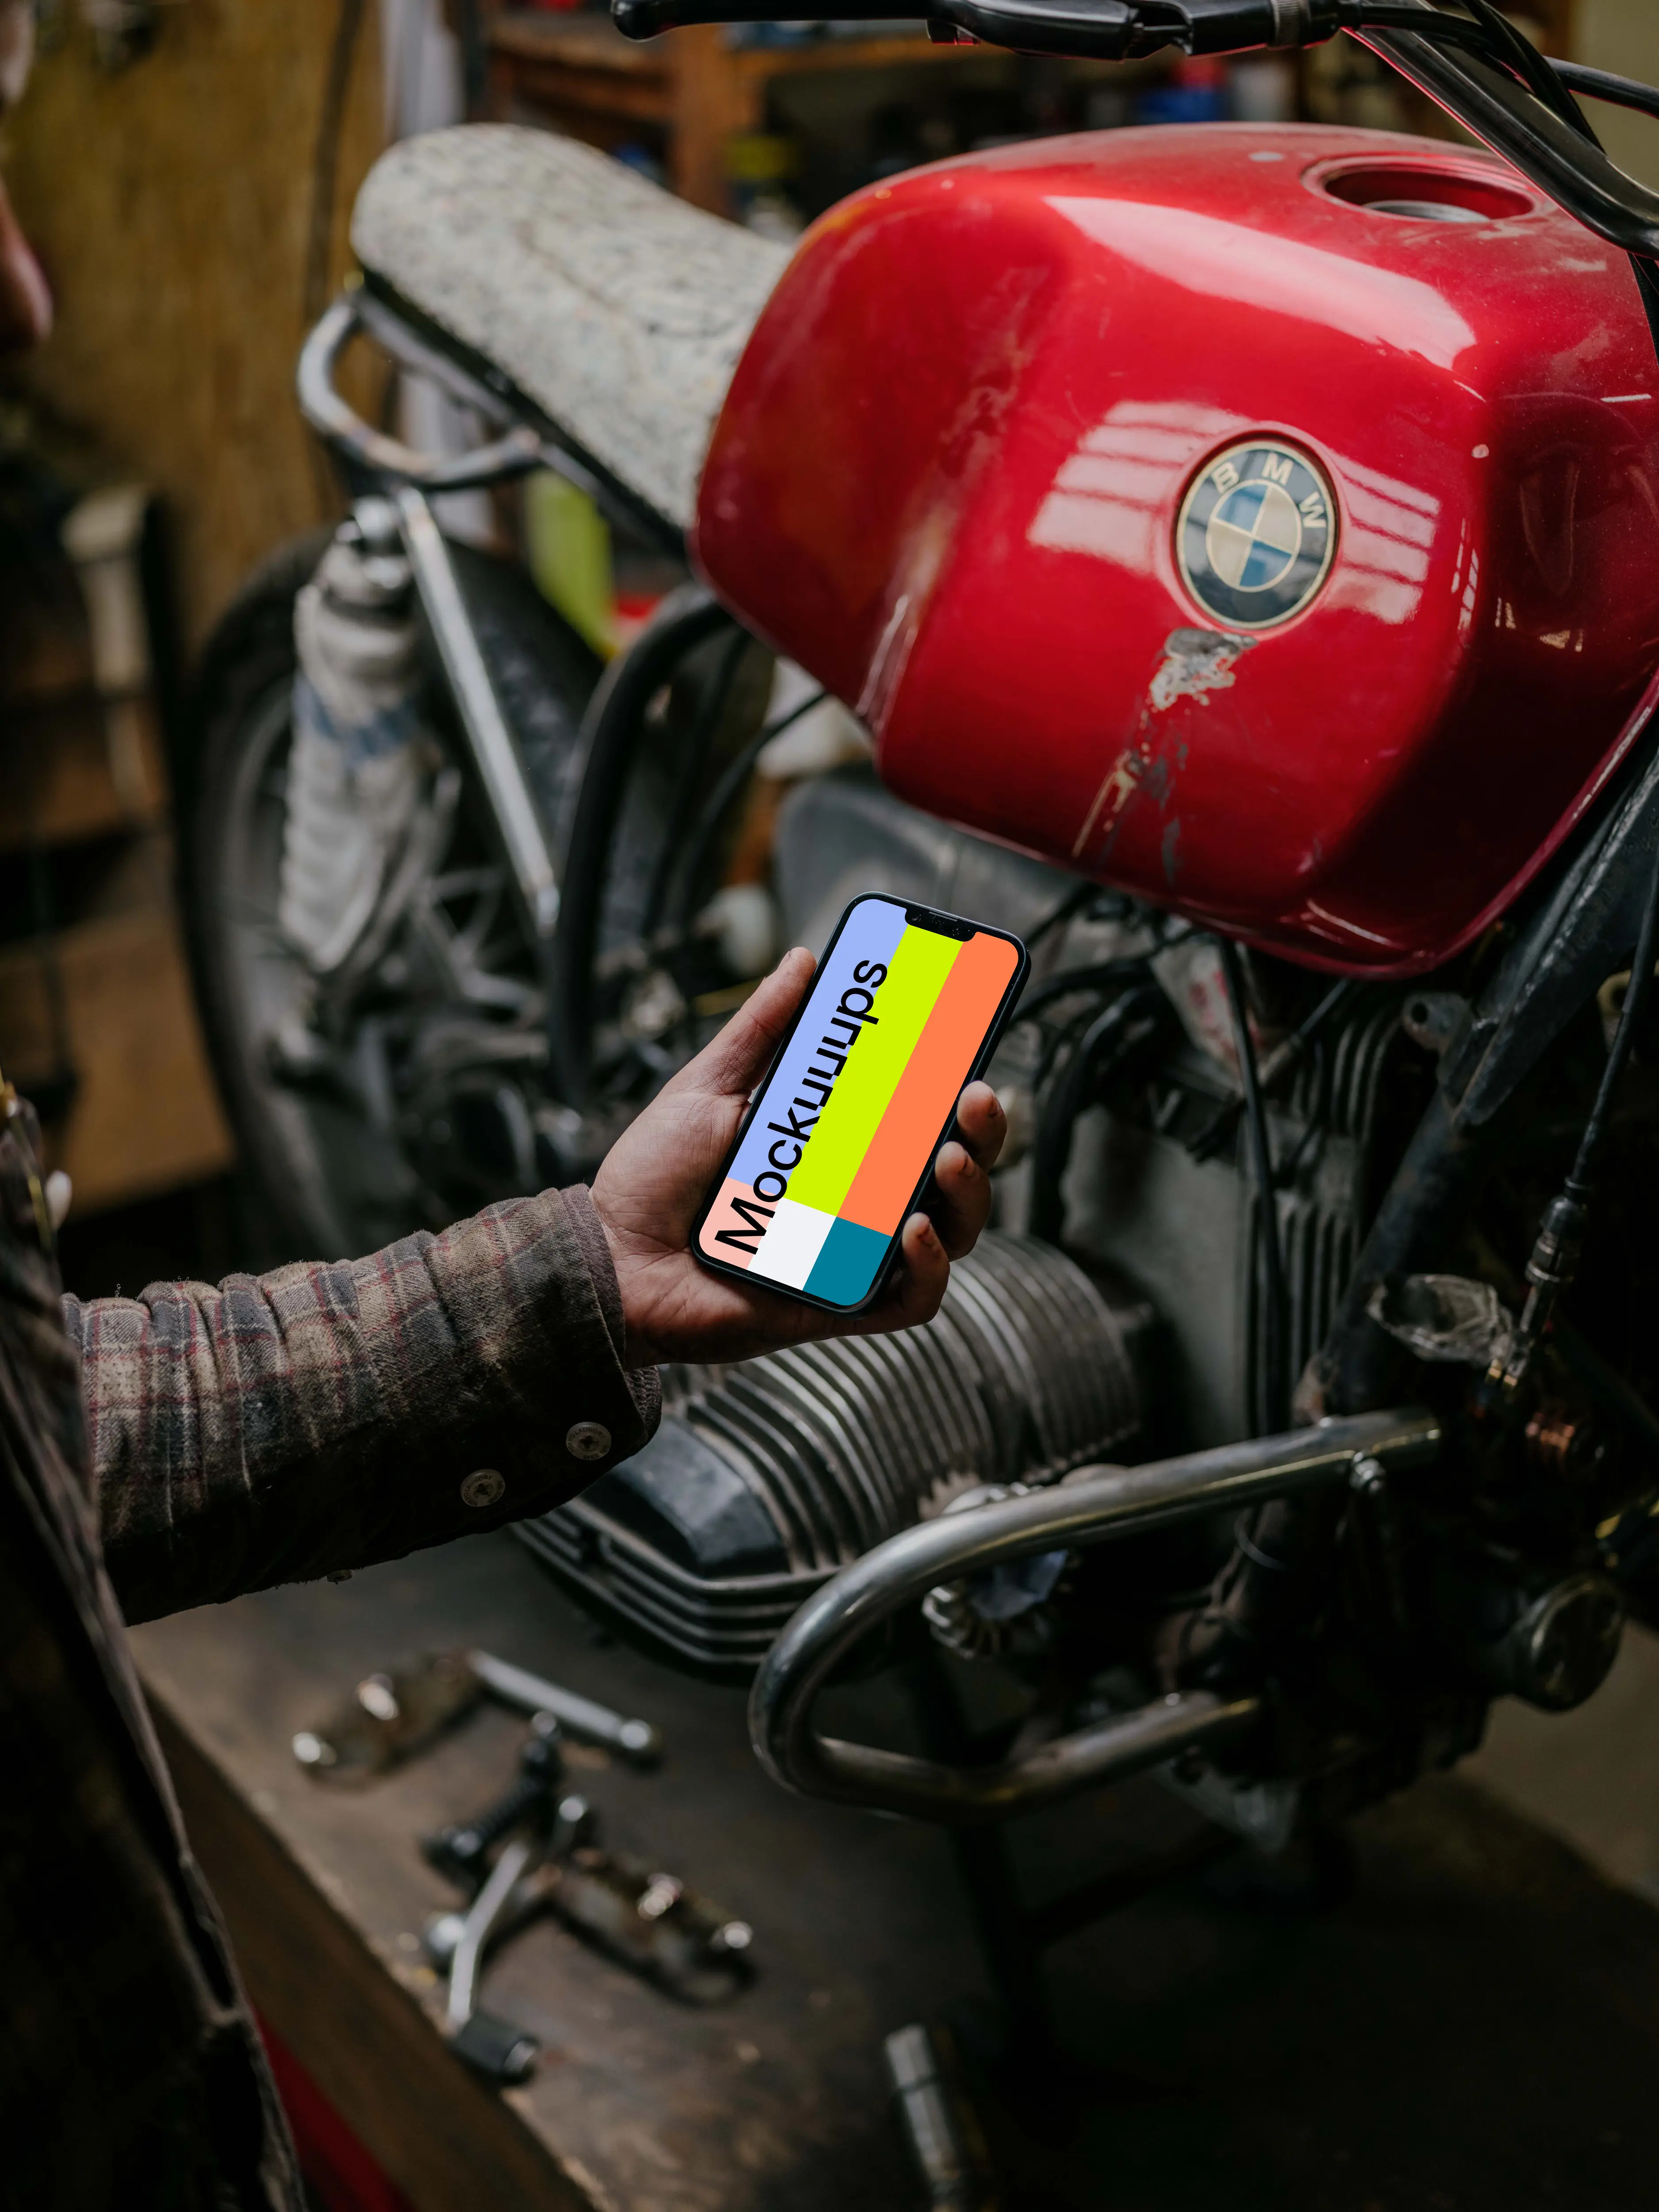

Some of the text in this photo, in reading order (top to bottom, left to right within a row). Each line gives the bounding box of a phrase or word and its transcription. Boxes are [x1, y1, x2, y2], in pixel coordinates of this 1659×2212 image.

[1211, 452, 1326, 528] BMW
[714, 959, 888, 1255] Mockuuups
[574, 1428, 606, 1438] LAUNDRY
[465, 1475, 492, 1491] LAUNDRY
